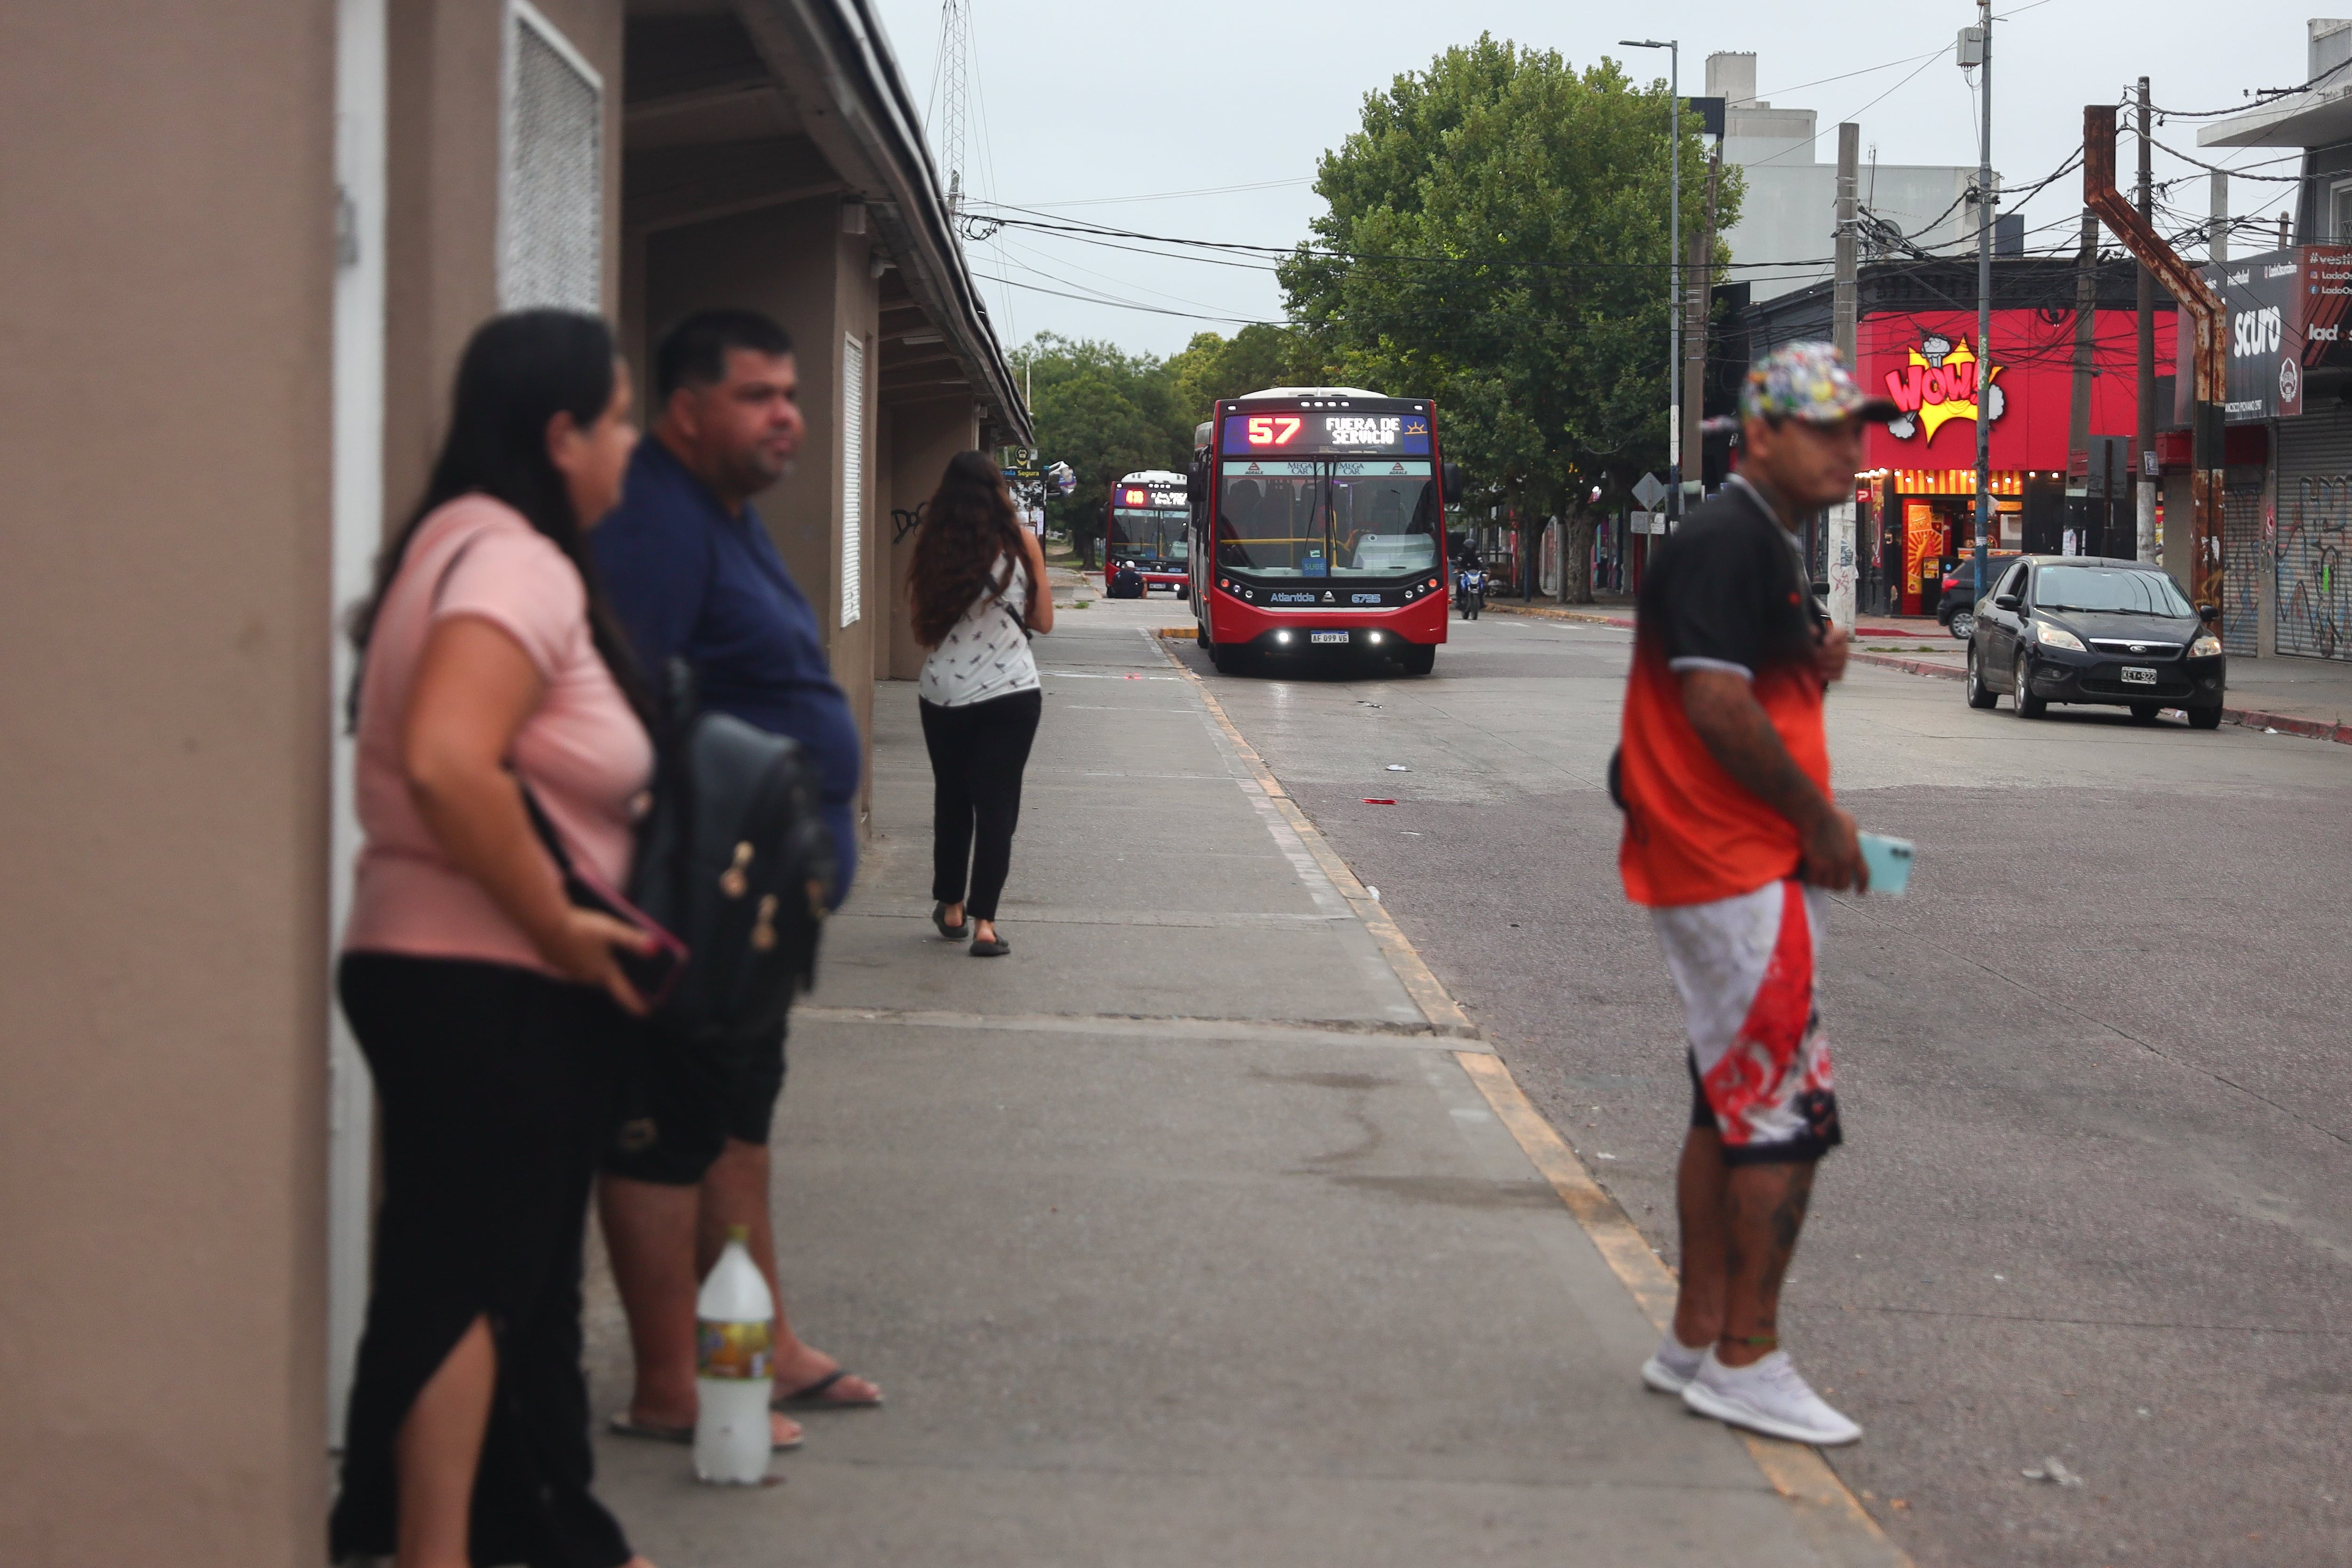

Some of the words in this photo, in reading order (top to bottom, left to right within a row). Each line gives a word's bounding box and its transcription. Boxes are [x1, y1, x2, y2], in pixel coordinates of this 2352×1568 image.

[2310, 252, 2352, 265] #vesti
[2234, 306, 2280, 357] scuro
[1326, 417, 1376, 430] FUERA
[1380, 417, 1400, 430] DE
[1249, 417, 1301, 444] 57
[1331, 430, 1395, 444] SERVICIO
[1351, 594, 1381, 603] 6735
[2141, 672, 2155, 681] 922
